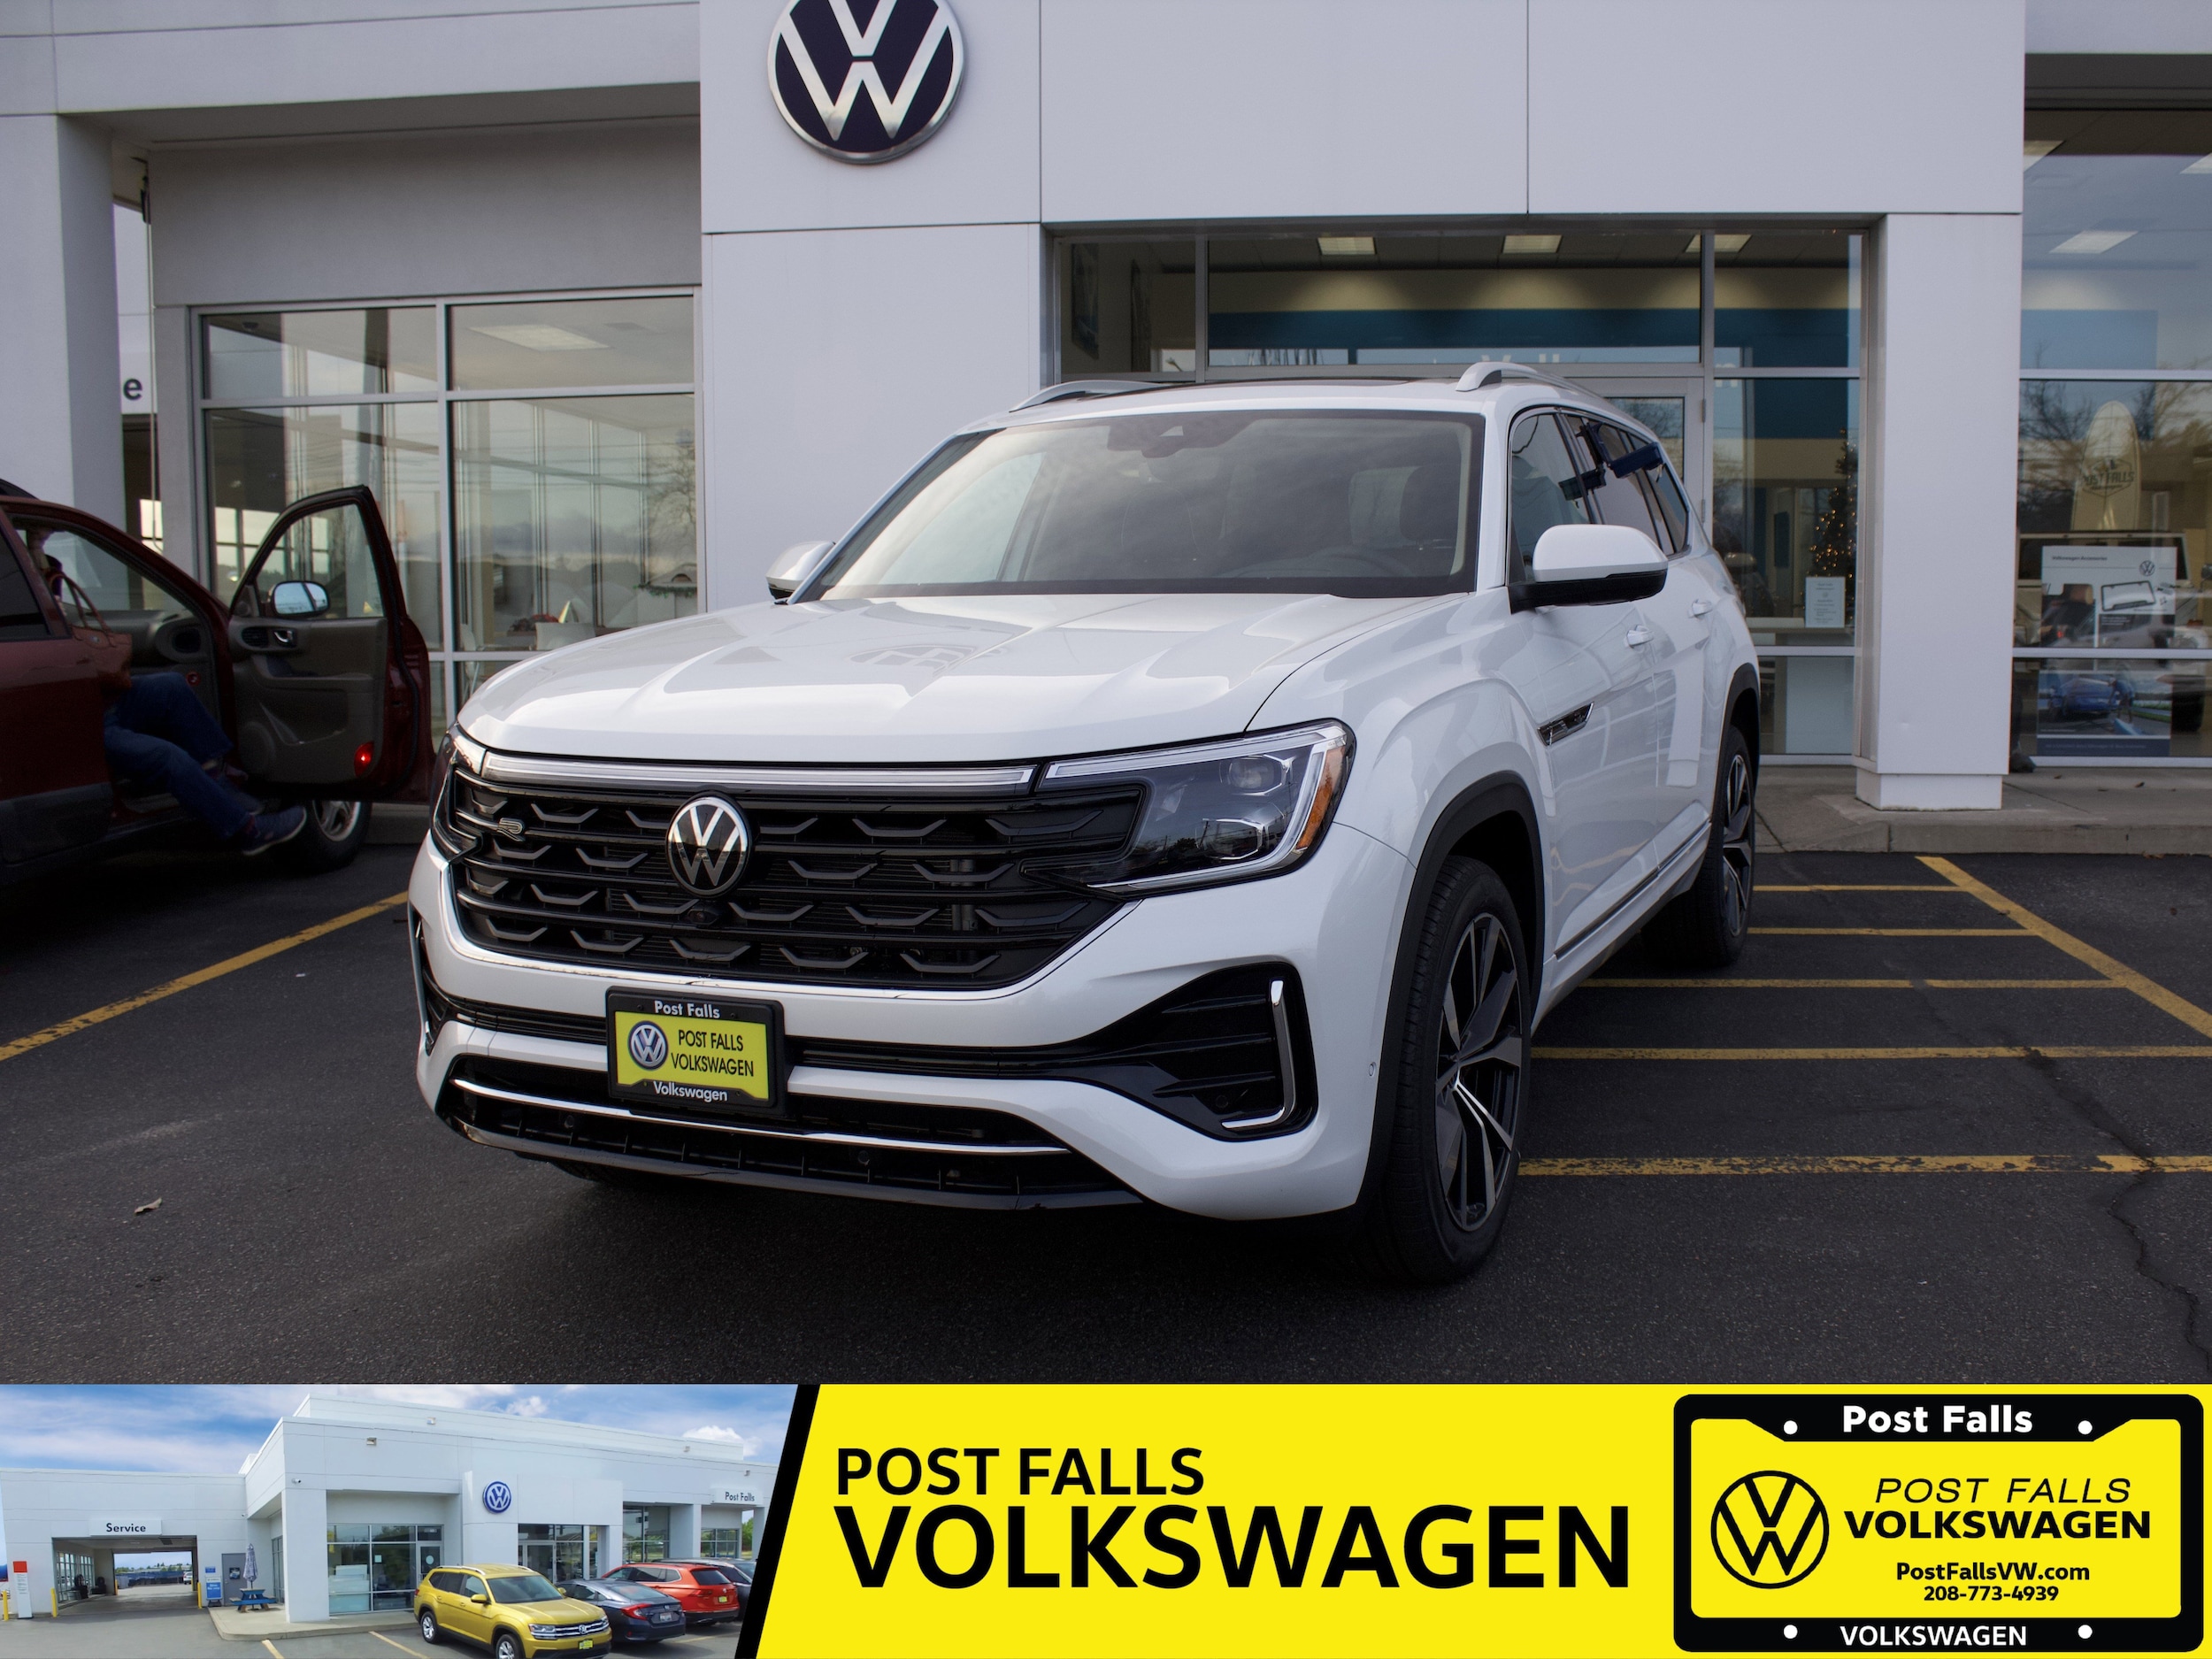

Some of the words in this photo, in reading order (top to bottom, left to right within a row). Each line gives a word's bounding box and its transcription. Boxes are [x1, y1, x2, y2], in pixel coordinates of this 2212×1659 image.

[654, 1001, 683, 1016] Post
[687, 1003, 720, 1018] Falls
[679, 1030, 707, 1048] POST
[710, 1033, 743, 1052] FALLS
[671, 1053, 754, 1077] VOLKSWAGEN
[653, 1081, 728, 1102] Volkswagen
